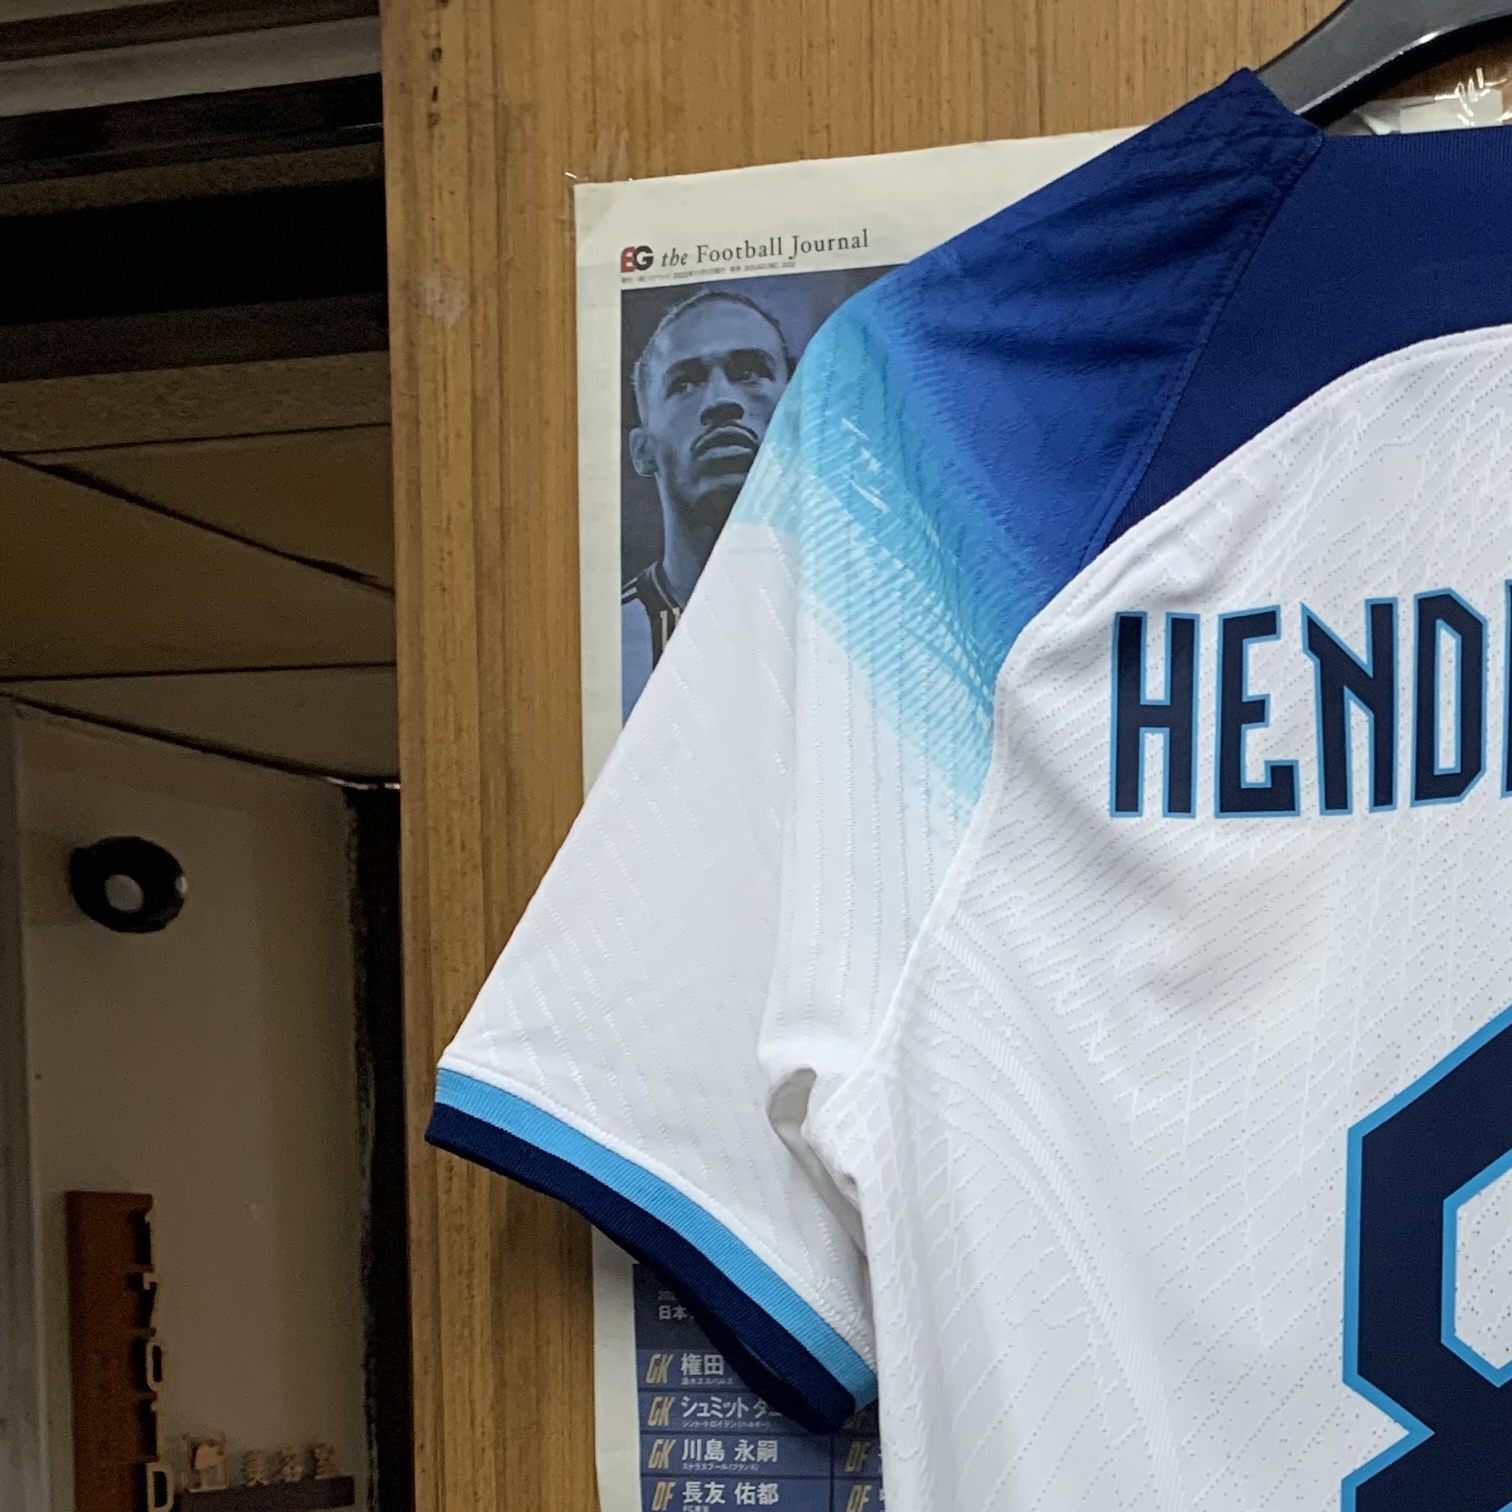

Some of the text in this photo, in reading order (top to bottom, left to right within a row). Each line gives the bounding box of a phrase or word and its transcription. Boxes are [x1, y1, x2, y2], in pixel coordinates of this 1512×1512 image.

[661, 247, 688, 268] the
[696, 236, 783, 263] Football
[788, 228, 869, 260] Journal
[658, 1304, 694, 1320] 日本
[645, 1353, 675, 1385] GK
[681, 1353, 724, 1376] 権田
[647, 1396, 676, 1427] GK
[681, 1395, 750, 1419] シュミット
[648, 1439, 677, 1470] GK
[681, 1438, 779, 1463] 川島 永嗣
[651, 1481, 676, 1512] DF
[682, 1480, 780, 1506] 長友 佑都
